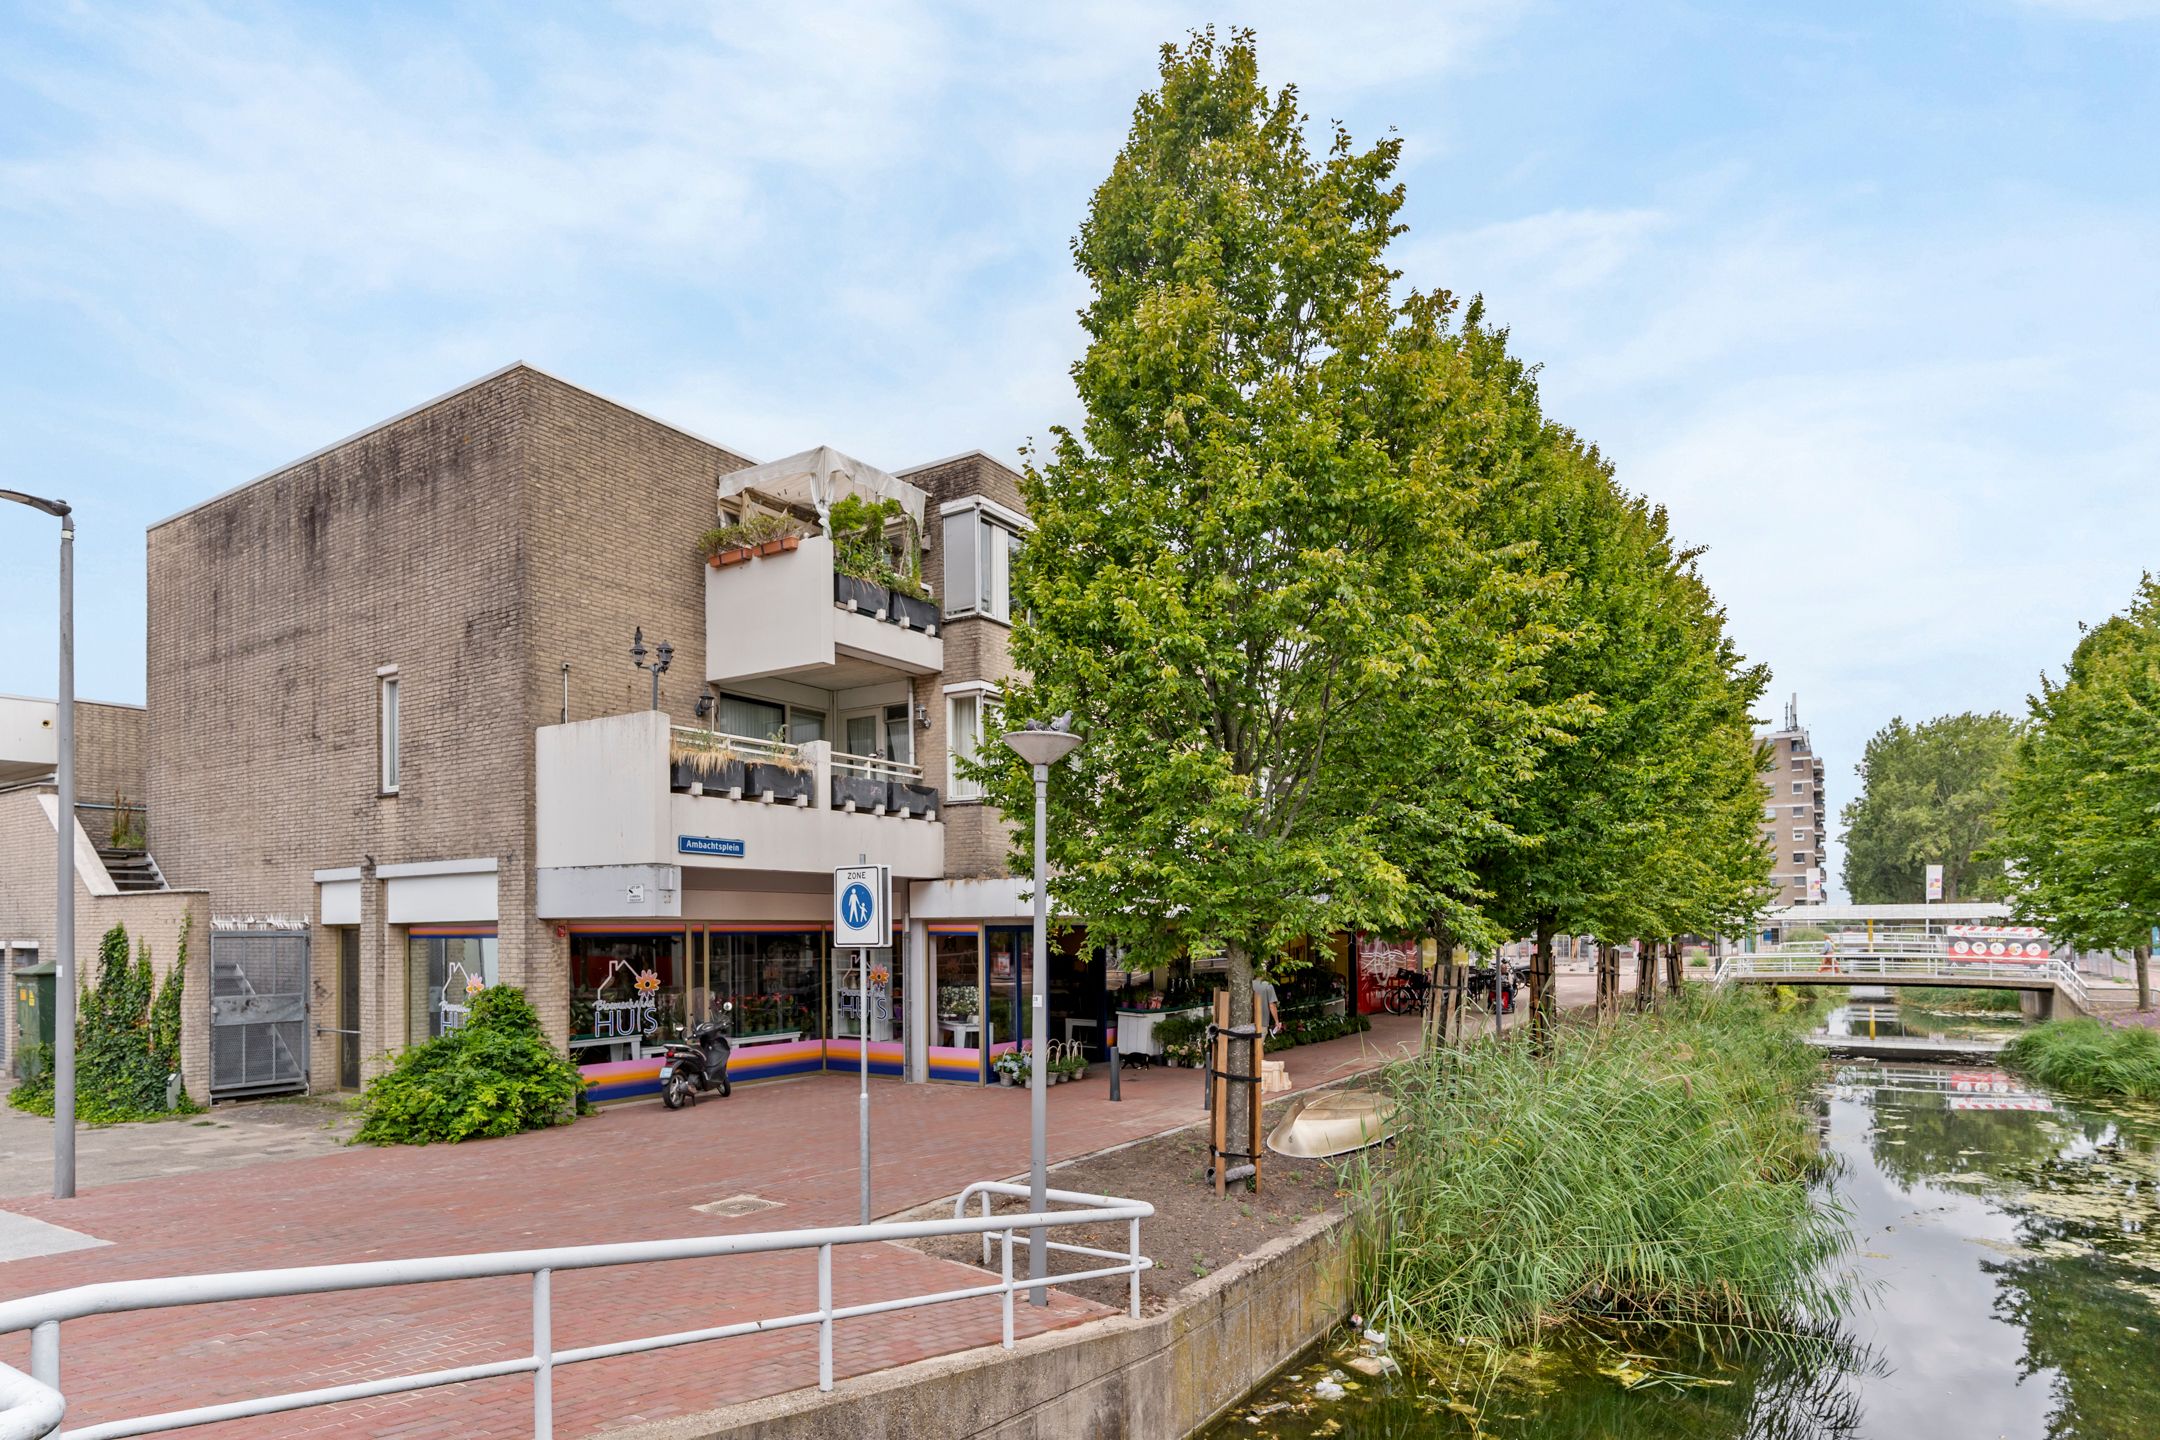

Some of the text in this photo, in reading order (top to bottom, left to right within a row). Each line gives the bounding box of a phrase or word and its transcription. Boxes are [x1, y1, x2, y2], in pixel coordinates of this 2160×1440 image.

[686, 840, 740, 852] Ambachtsplein
[847, 871, 866, 880] ZONE
[594, 1007, 658, 1038] HUIS
